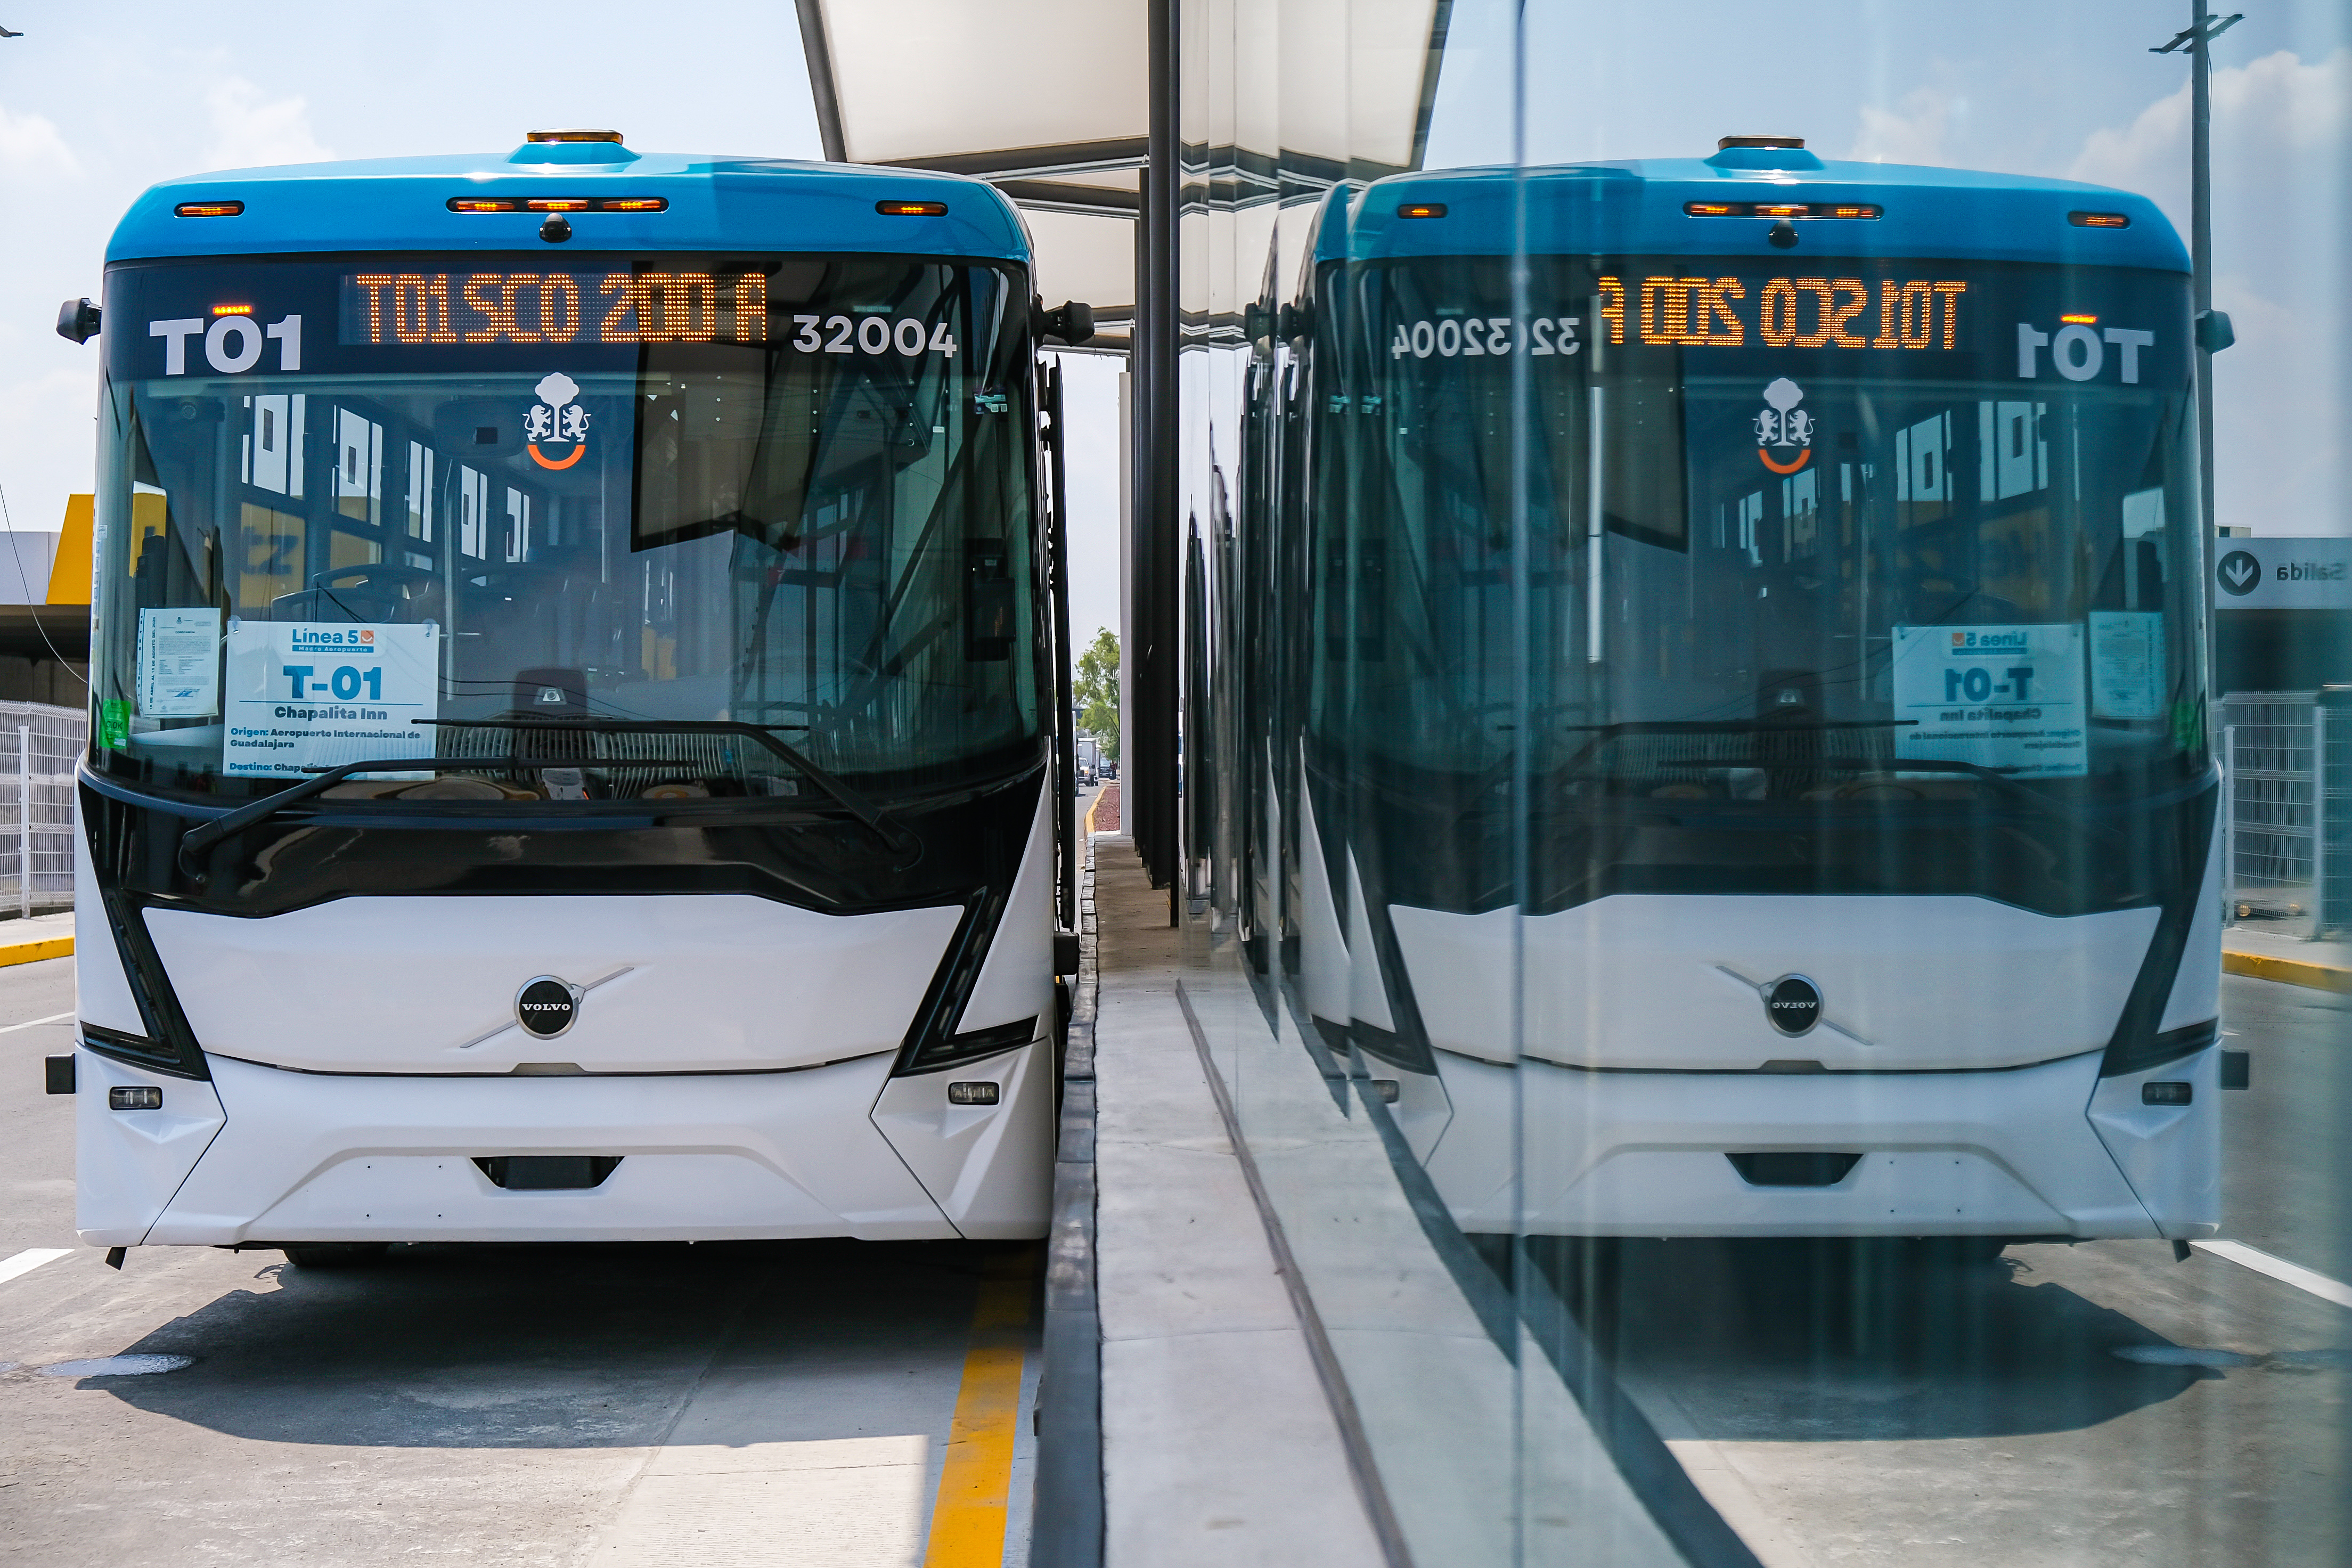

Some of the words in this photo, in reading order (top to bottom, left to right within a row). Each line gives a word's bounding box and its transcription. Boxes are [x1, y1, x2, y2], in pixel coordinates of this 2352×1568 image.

[793, 314, 957, 358] 32004
[292, 628, 343, 643] Línea
[347, 630, 358, 644] 5
[283, 665, 381, 700] T-01
[274, 705, 357, 722] Chapalita
[361, 708, 387, 720] Inn
[231, 726, 269, 738] Origen:
[270, 728, 332, 738] Aeropuerto
[333, 729, 406, 739] Internacional
[230, 739, 295, 750] Guadalajara
[230, 762, 272, 771] Destino:
